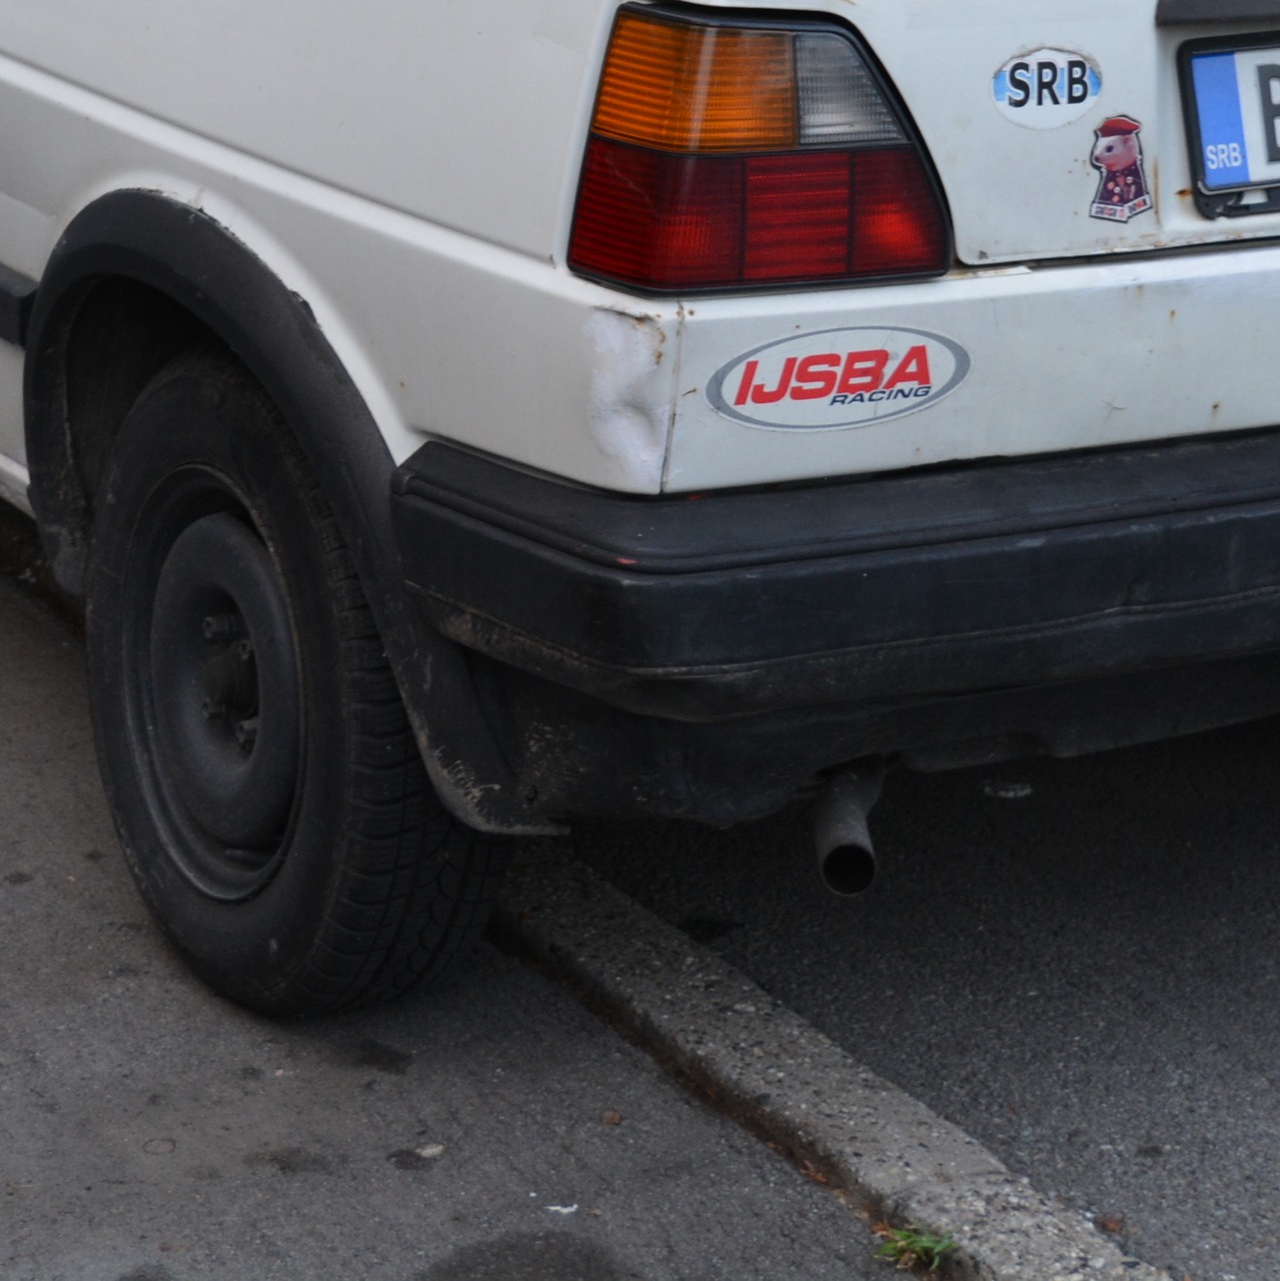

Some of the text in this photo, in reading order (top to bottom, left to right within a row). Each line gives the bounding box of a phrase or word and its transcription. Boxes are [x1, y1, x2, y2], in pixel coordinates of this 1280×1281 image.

[1008, 59, 1089, 108] SRB
[1205, 142, 1243, 171] SRB
[733, 344, 932, 406] IJSBA
[829, 385, 932, 407] RACING
